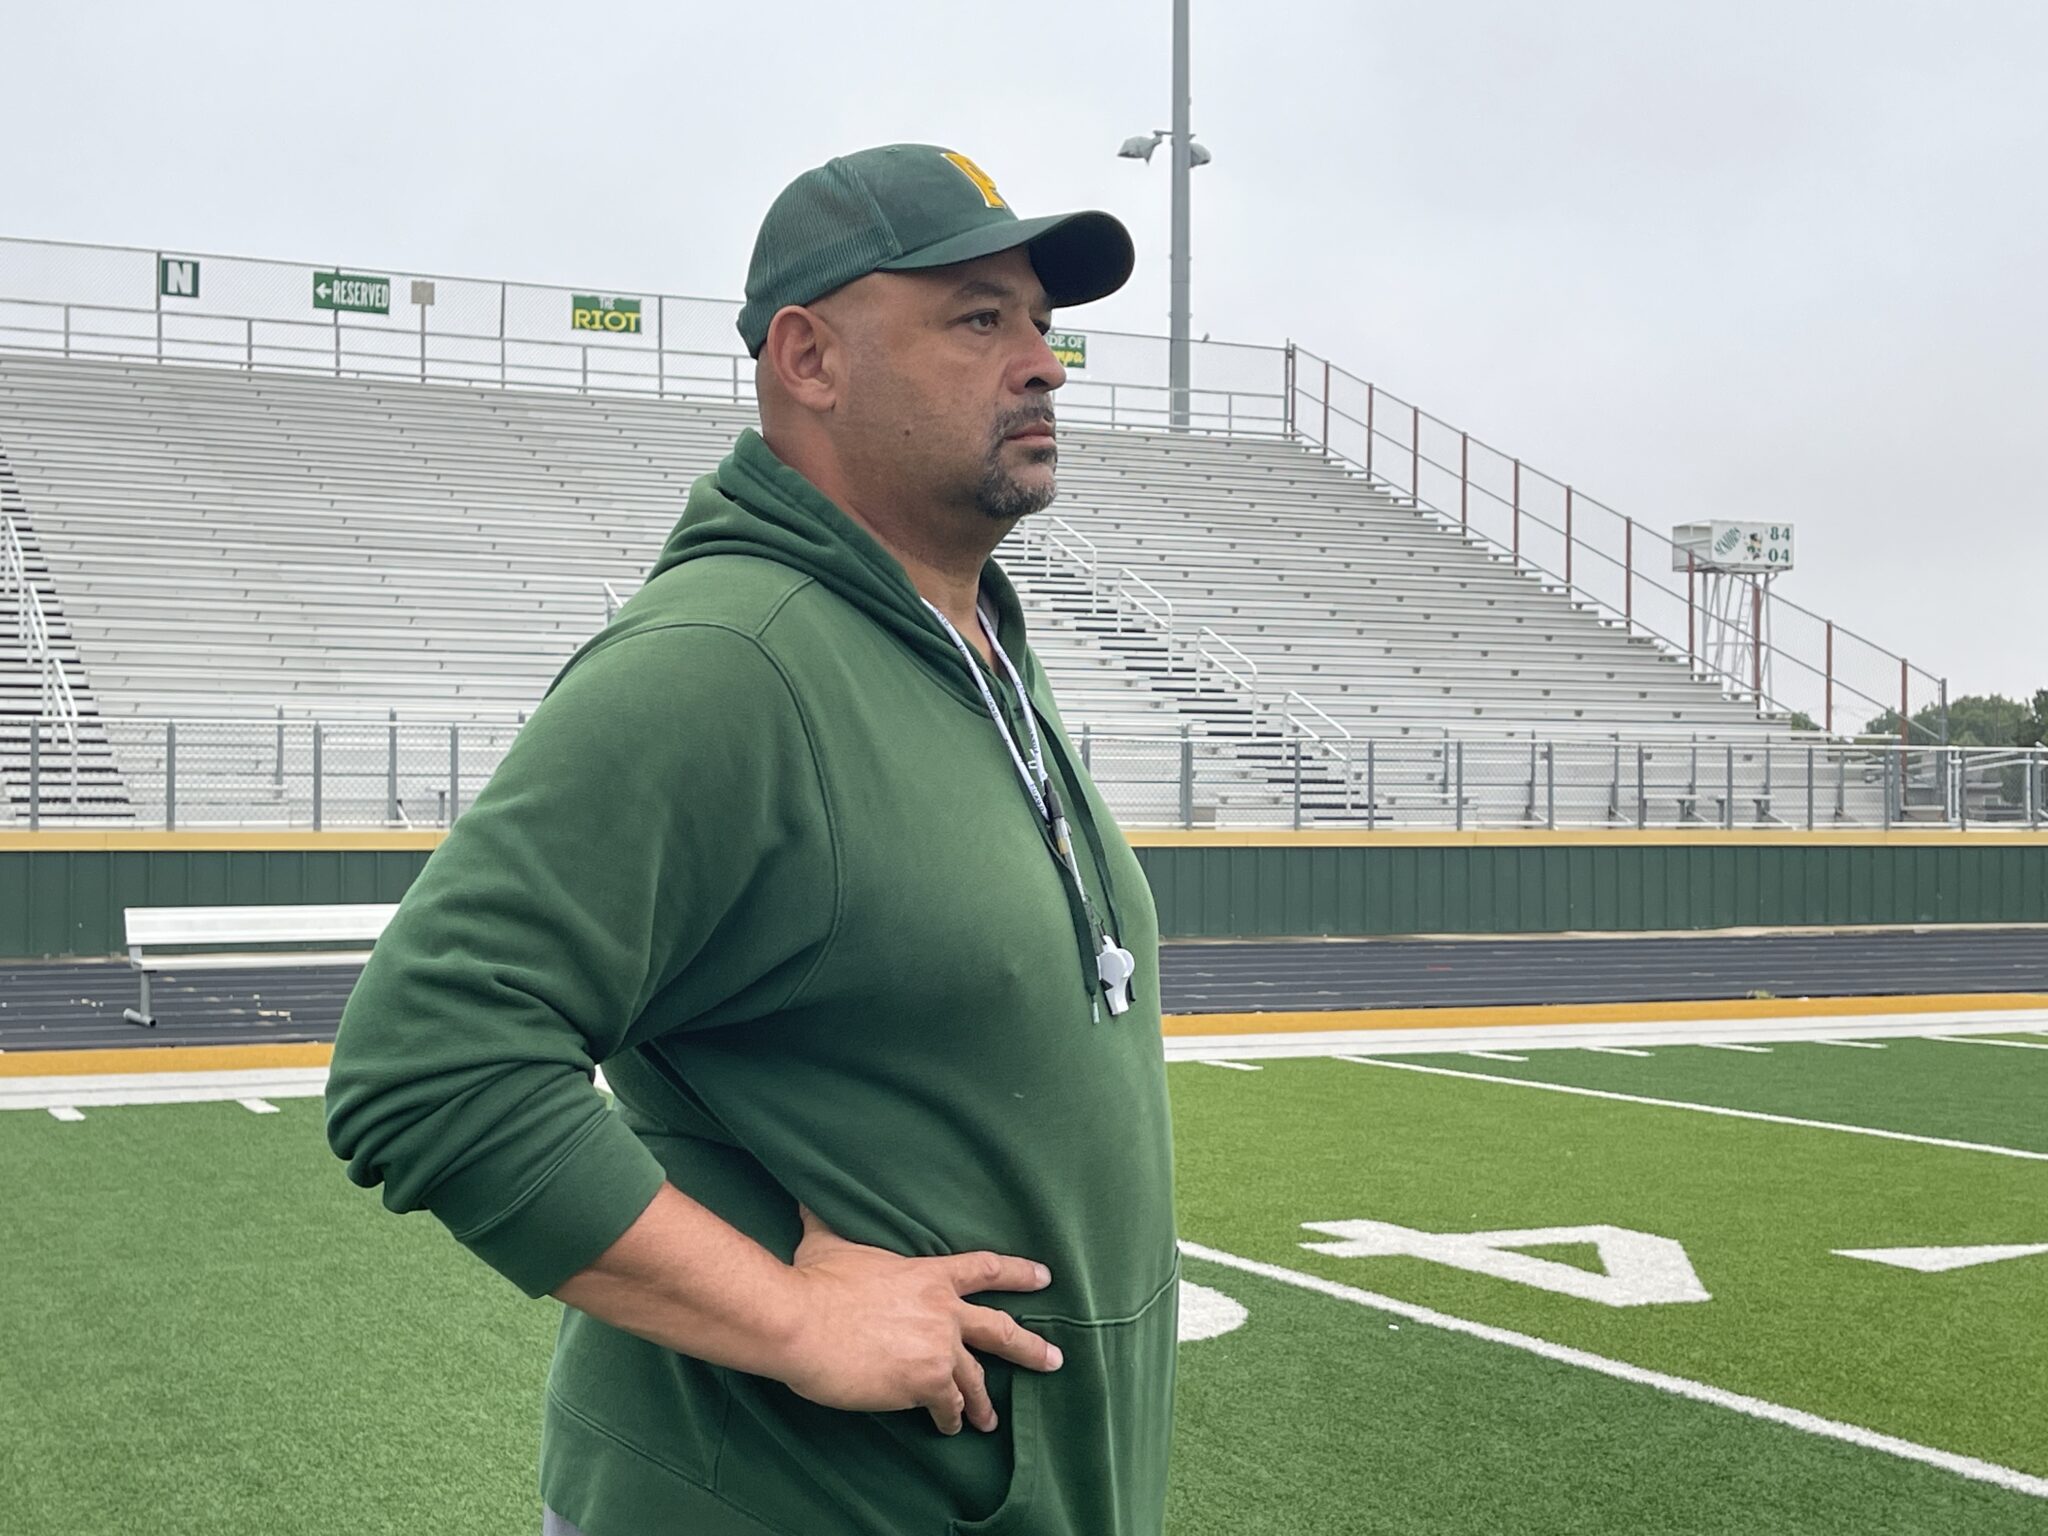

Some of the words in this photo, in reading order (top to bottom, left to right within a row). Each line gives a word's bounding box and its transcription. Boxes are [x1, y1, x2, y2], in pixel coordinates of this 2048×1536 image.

[166, 260, 193, 295] N
[332, 279, 389, 309] RESERVED
[574, 308, 641, 332] RIOT
[1067, 336, 1084, 348] OF
[1769, 526, 1791, 541] 84
[1768, 548, 1790, 562] 04
